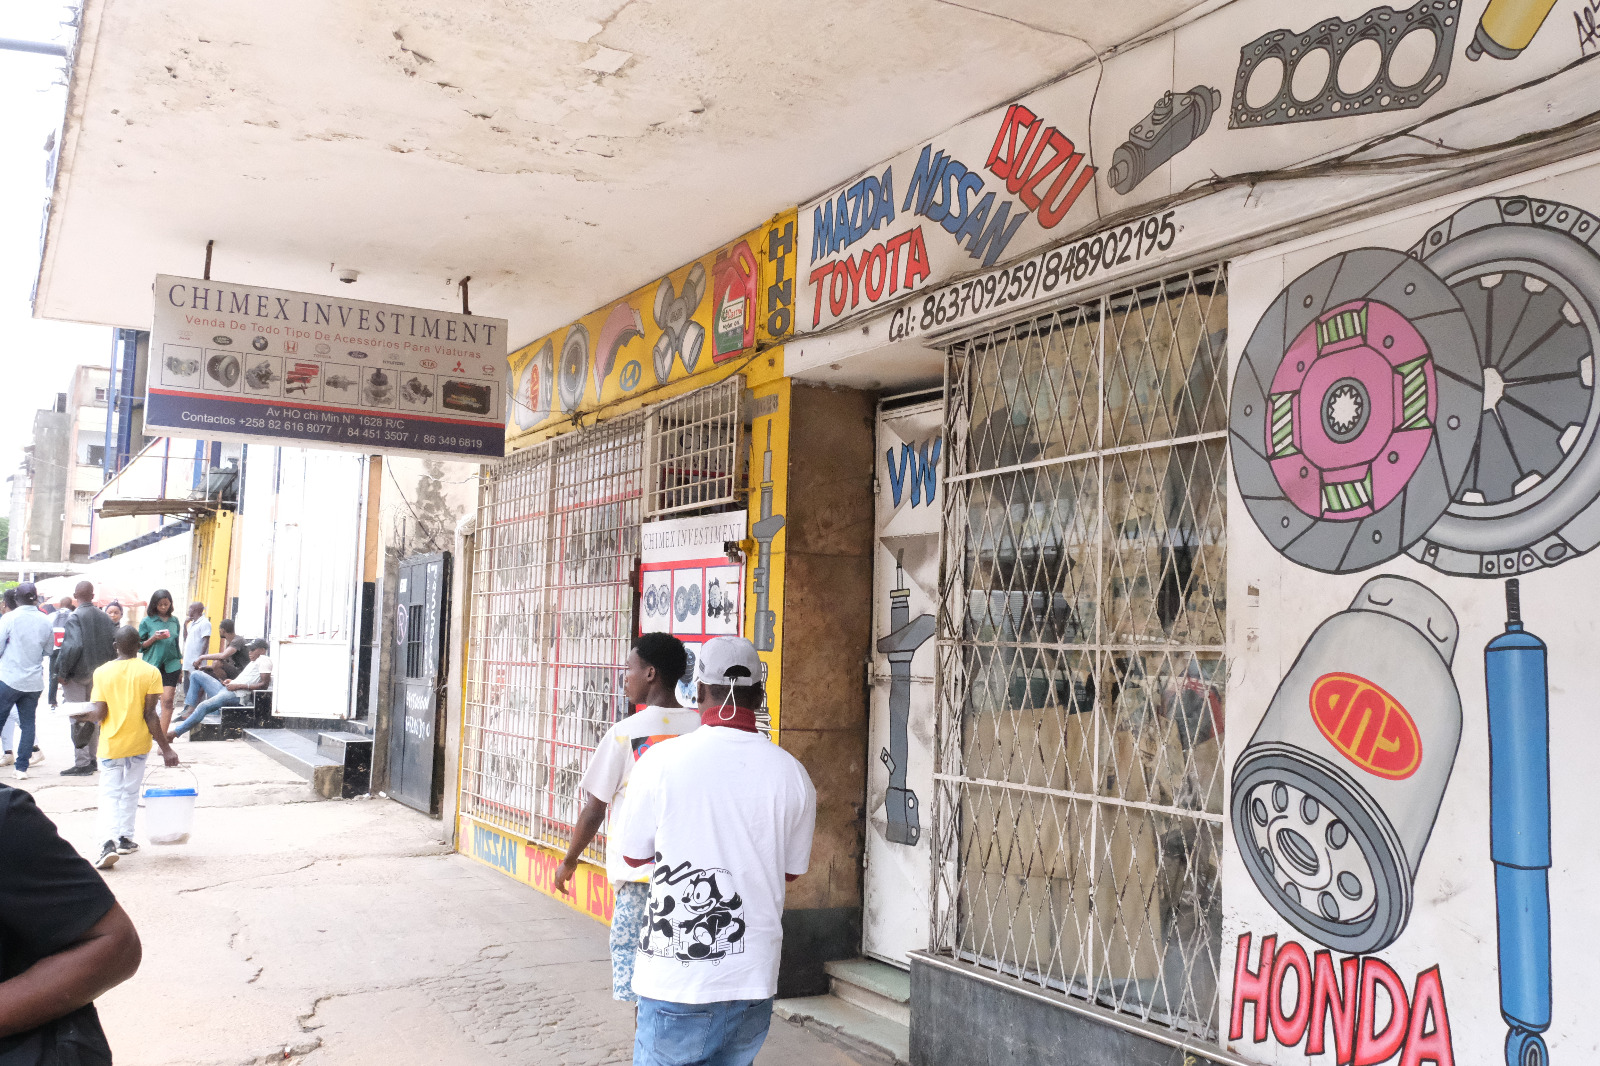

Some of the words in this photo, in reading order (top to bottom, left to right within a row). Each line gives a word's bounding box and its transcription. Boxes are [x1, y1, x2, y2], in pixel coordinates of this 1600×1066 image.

[984, 103, 1098, 229] ISUZU
[810, 165, 895, 265] MAZDA
[901, 143, 1030, 268] NISSAN
[767, 221, 794, 337] HINO
[808, 224, 931, 330] TOYOTA
[168, 284, 290, 321] CHIMEX
[302, 301, 497, 346] INVESTIMENT
[185, 315, 225, 329] Venda
[230, 320, 247, 331] De
[251, 323, 280, 335] Todo
[284, 326, 311, 340] Tipo
[315, 331, 331, 341] De
[334, 333, 400, 350] Acessórios
[403, 341, 430, 354] Para
[434, 345, 481, 359] Viaturas
[422, 359, 435, 369] KIA
[181, 411, 236, 425] Contactos
[239, 417, 265, 428] +258
[268, 419, 281, 430] 82
[284, 421, 304, 432] 616
[306, 423, 332, 434] 8077
[347, 428, 359, 438] 84
[362, 429, 380, 439] 451
[384, 431, 409, 442] 3507
[423, 434, 436, 444] 86
[438, 436, 456, 446] 349
[458, 437, 483, 448] 6819
[266, 407, 281, 417] Av
[283, 409, 301, 419] HO
[303, 411, 319, 421] chi
[321, 413, 340, 423] Min
[359, 417, 383, 427] 1628
[385, 419, 405, 429] R/C
[886, 436, 943, 509] VW
[643, 531, 675, 550] CHIMEX
[677, 523, 742, 547] INVESTIMENT
[473, 826, 517, 875] NISSAN
[525, 845, 578, 905] TOYOA
[587, 870, 614, 922] ISU
[1229, 931, 1455, 1066] HONDA
